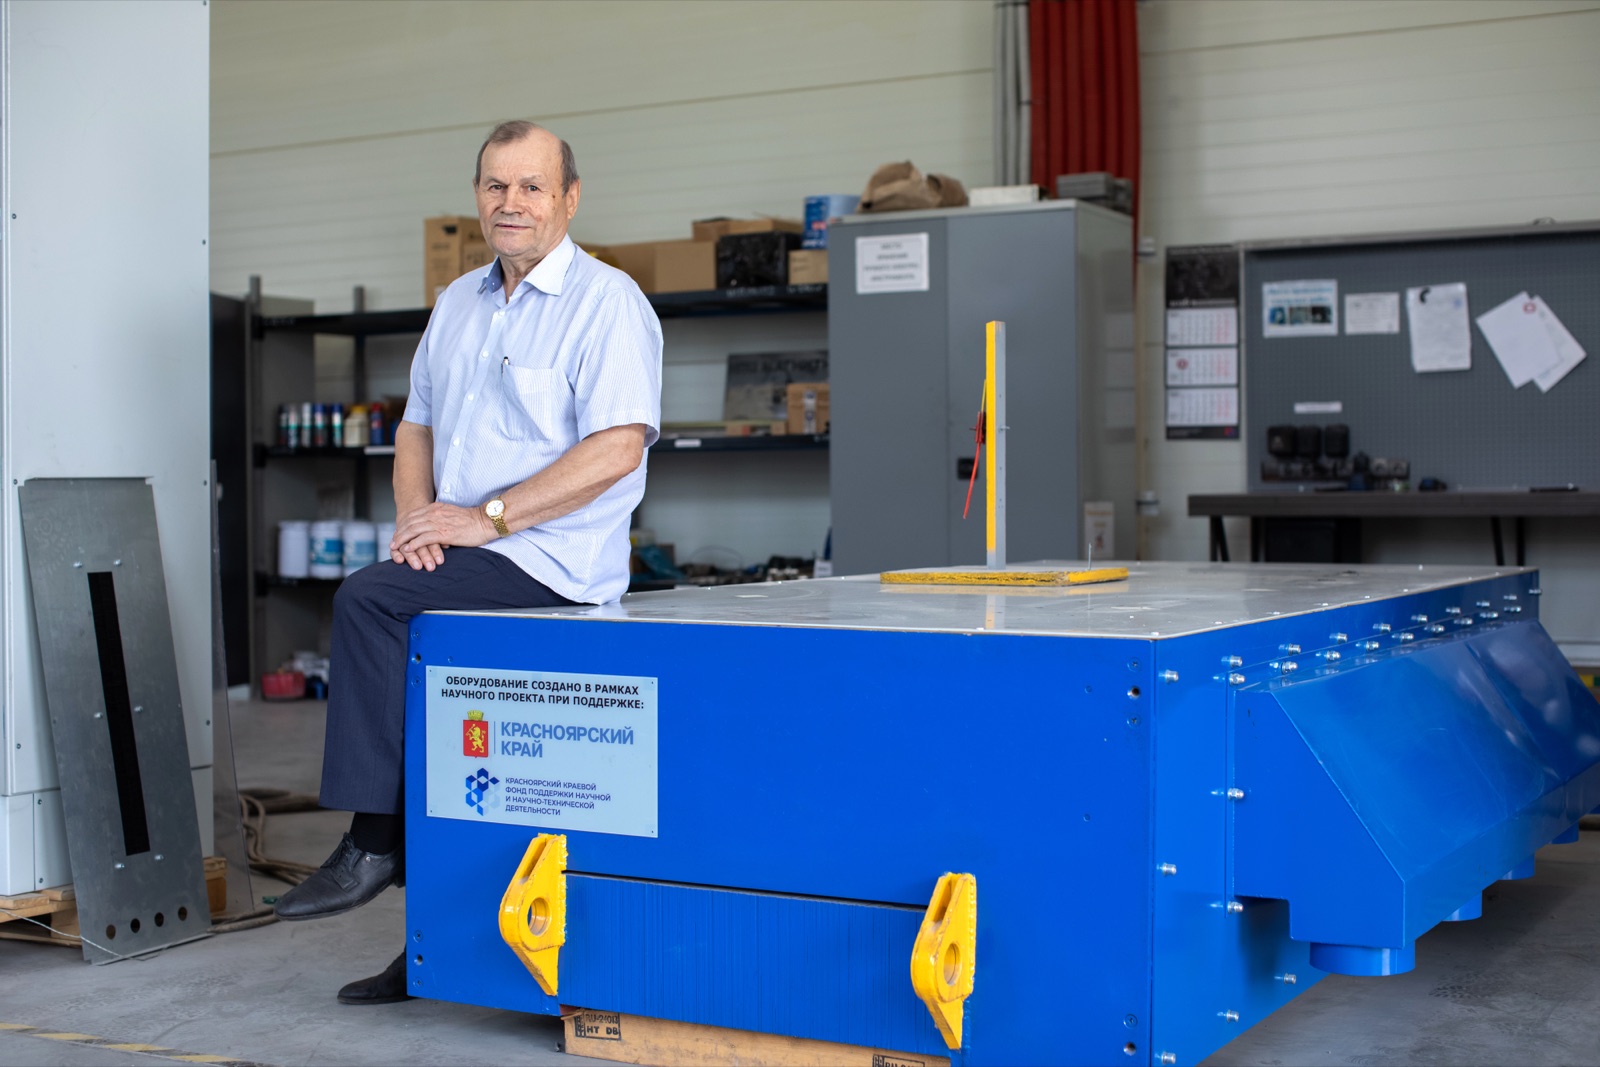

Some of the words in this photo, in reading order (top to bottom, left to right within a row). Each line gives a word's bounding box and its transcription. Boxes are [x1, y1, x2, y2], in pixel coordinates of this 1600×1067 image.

[446, 676, 528, 689] ОБОРУДОВАНИЕ
[531, 681, 582, 692] СОЗДАНО
[585, 684, 592, 693] В
[595, 684, 639, 695] РАМКАХ
[441, 689, 495, 700] НАУЧНОГО
[498, 692, 545, 703] ПРОЕКТА
[548, 695, 570, 705] ПРИ
[573, 696, 644, 709] ПОДДЕРЖКЕ:
[501, 721, 634, 745] КРАСНОЯРСКИЙ
[501, 740, 543, 758] КРАЙ
[505, 777, 562, 788] КРАСНОЯРСКИЙ
[563, 782, 597, 791] КРАЕВОЙ
[505, 786, 527, 795] ФОНД
[528, 788, 574, 798] ПОДДЕРЖКИ
[575, 793, 611, 802] НАУЧНОЙ
[505, 804, 561, 816] ДЕЯТЕЛЬНОСТИ
[512, 796, 595, 809] НАУЧНО-ТЕХНИЧЕСКОЙ
[586, 1025, 600, 1034] HT
[606, 1026, 619, 1035] DB
